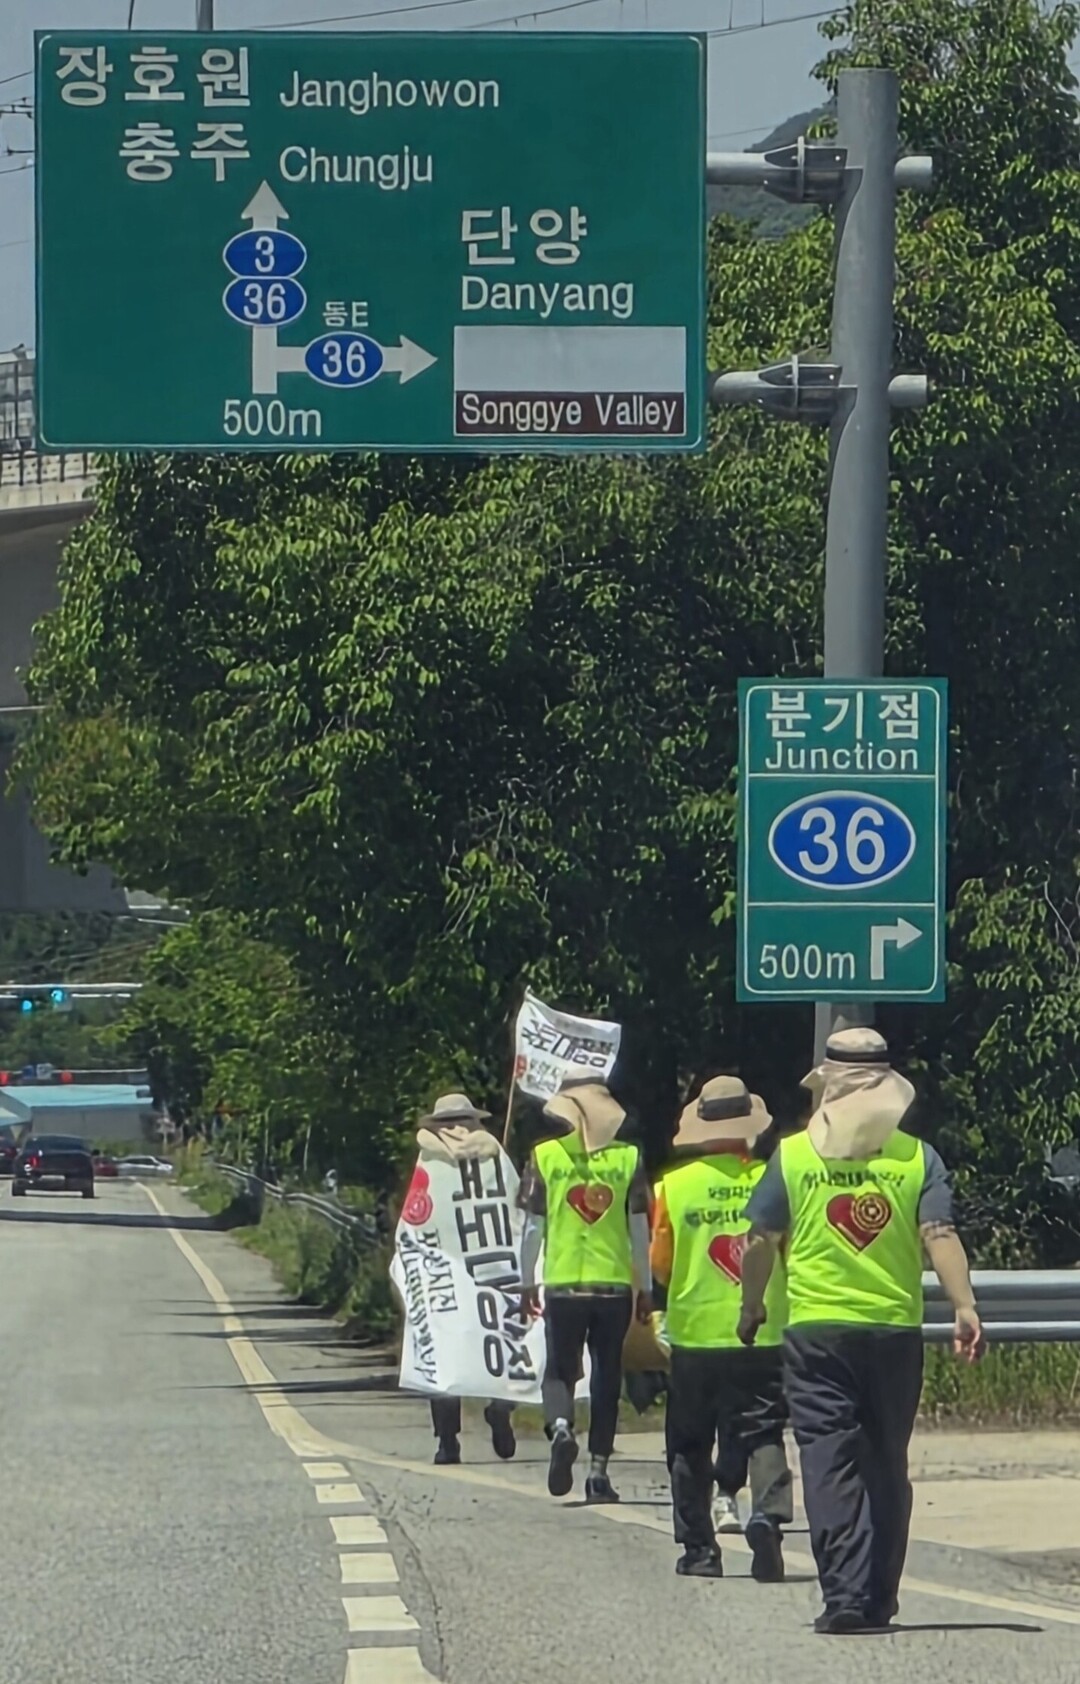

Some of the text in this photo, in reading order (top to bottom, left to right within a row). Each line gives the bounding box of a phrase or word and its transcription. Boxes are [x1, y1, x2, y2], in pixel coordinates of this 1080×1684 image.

[55, 45, 252, 108] 장호원
[279, 71, 500, 109] Janghowon
[119, 122, 251, 182] 충주
[278, 145, 433, 190] Chungju
[254, 236, 276, 273] 3
[461, 206, 588, 265] 단양
[242, 281, 288, 321] 36
[461, 275, 634, 319] Danyang
[321, 341, 367, 379] 36
[223, 400, 322, 437] 500m
[462, 393, 677, 433] Songgye Valley
[766, 690, 919, 740] 분기점
[765, 740, 918, 770] Junction
[798, 806, 886, 875] 36
[759, 943, 856, 980] 500m
